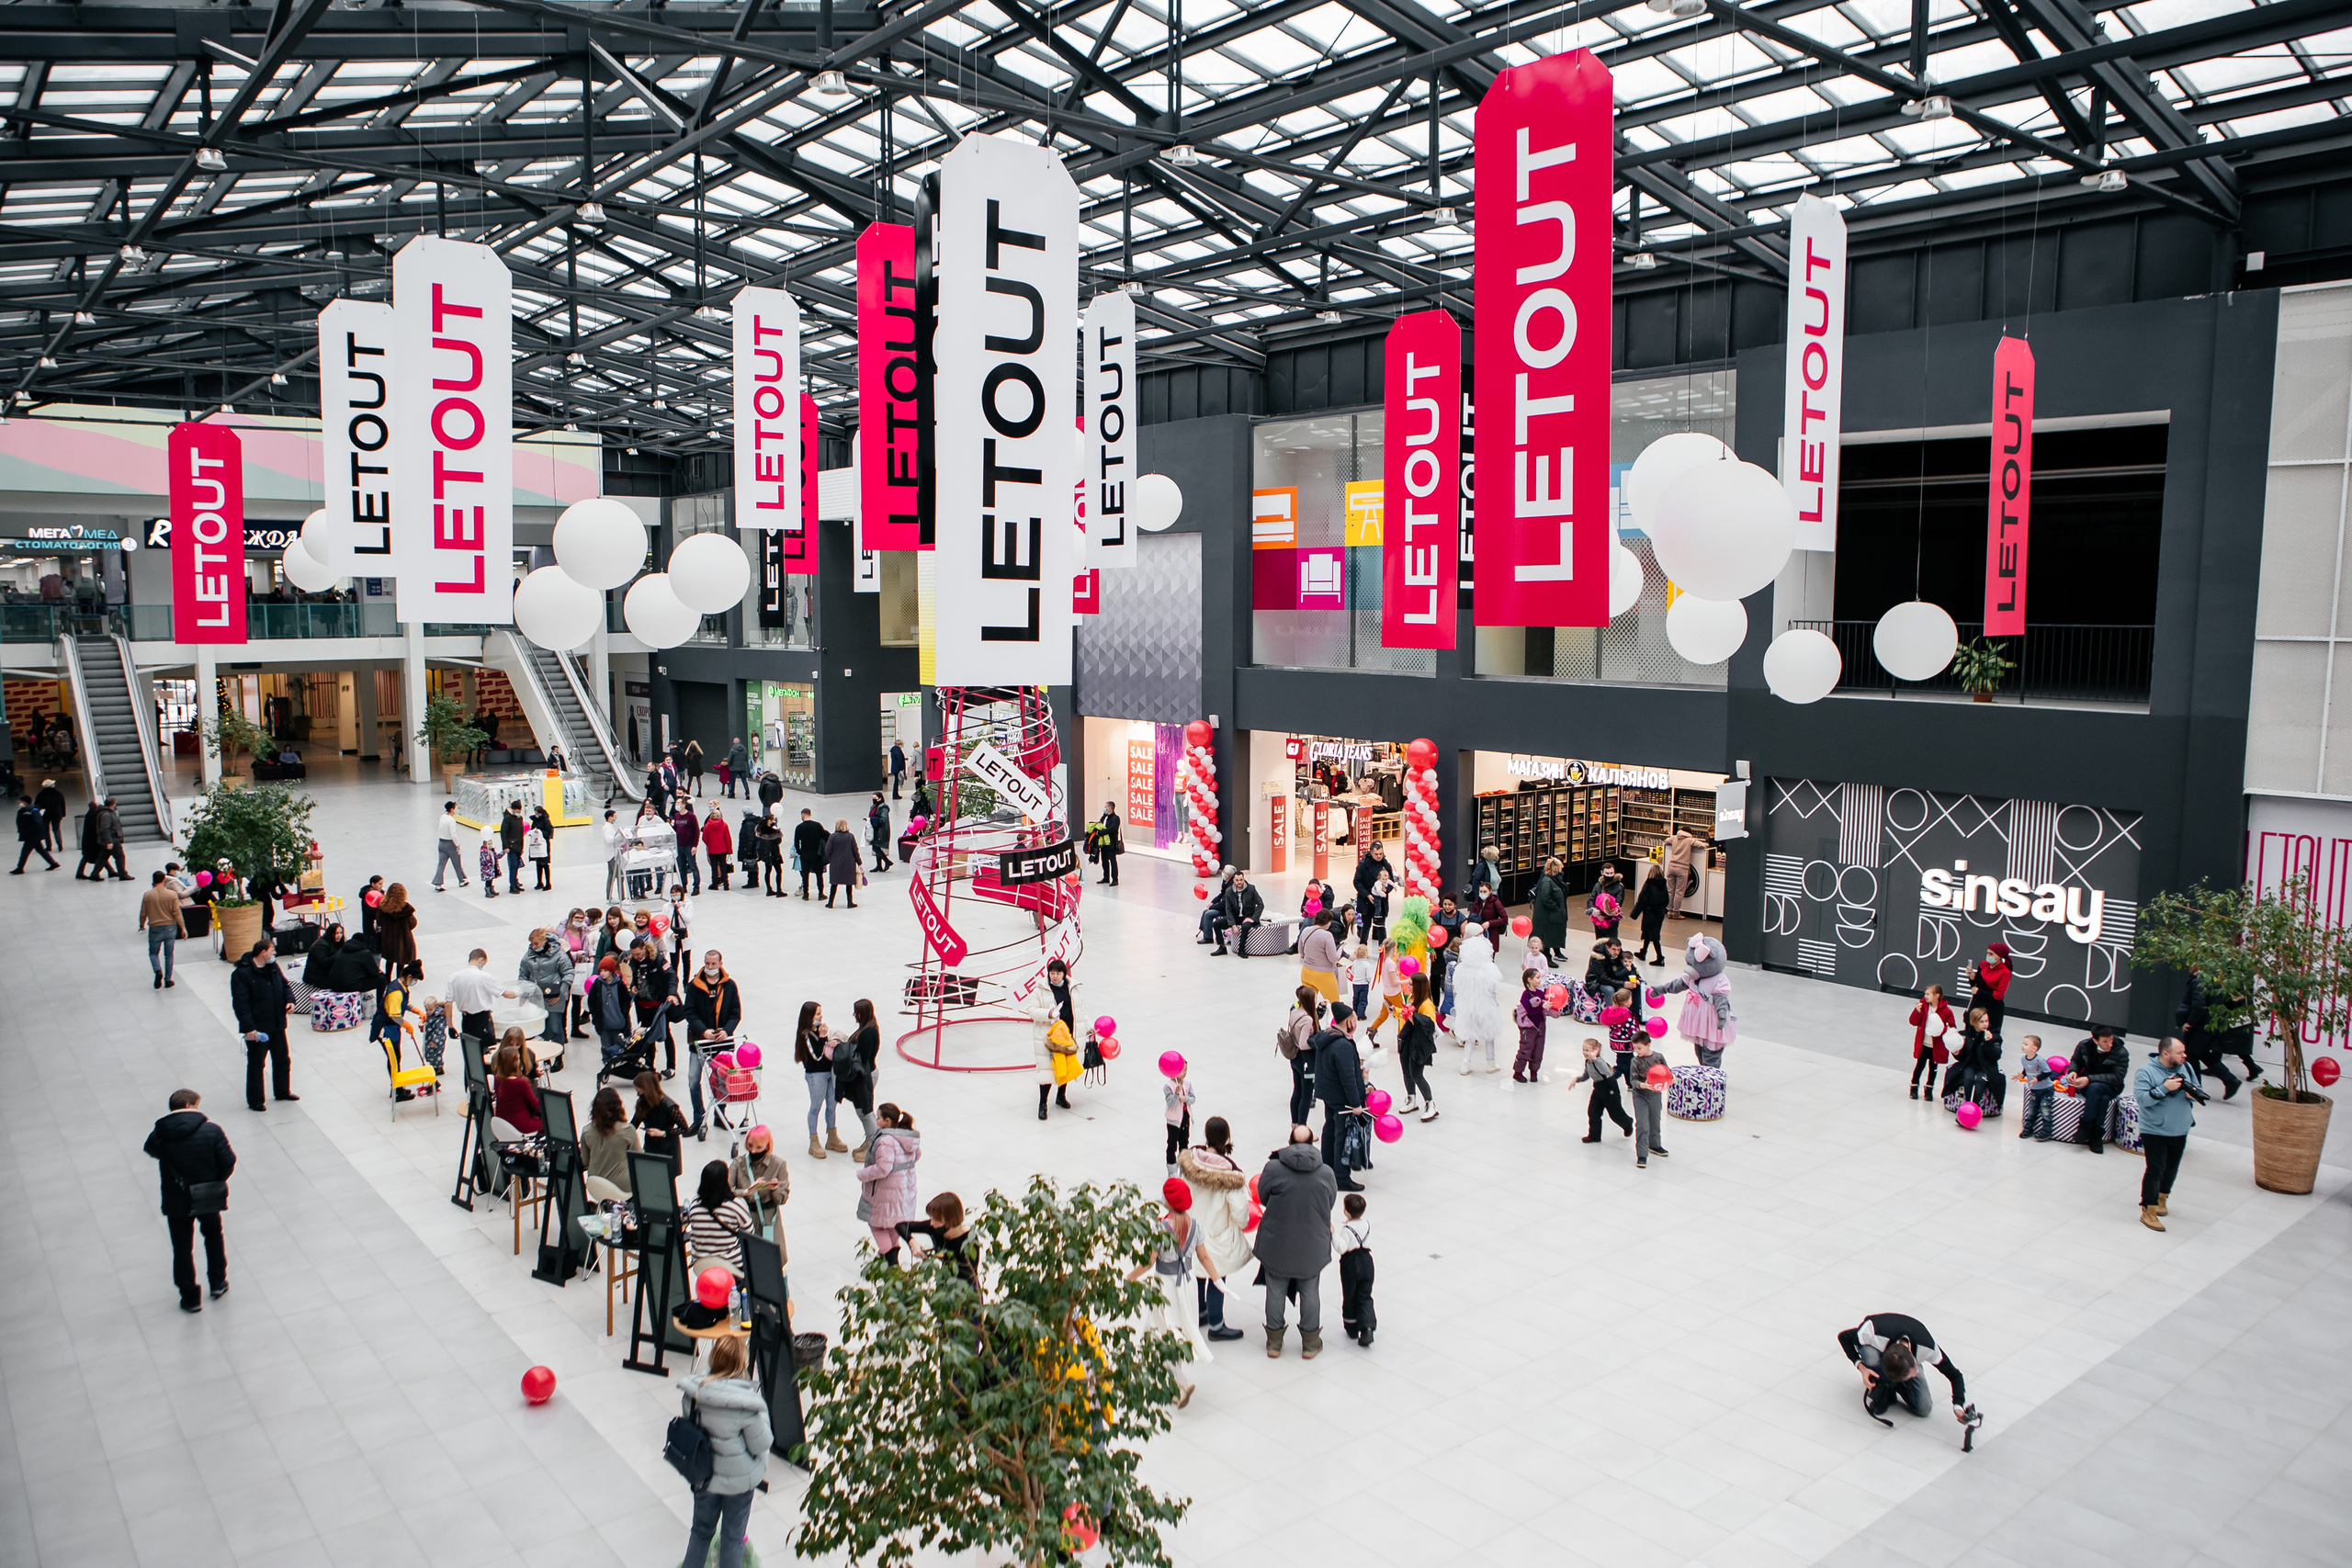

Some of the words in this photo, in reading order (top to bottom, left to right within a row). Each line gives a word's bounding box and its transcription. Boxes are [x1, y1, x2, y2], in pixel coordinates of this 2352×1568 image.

[1514, 126, 1578, 583] LETOUT
[1799, 236, 1832, 523] LETOUT
[752, 314, 786, 510] LETOUT
[884, 260, 920, 525] LETOUT
[980, 198, 1046, 642] LETOUT
[346, 332, 391, 555] LETOUT
[430, 282, 486, 594] LETOUT
[1100, 326, 1125, 547] LETOUT
[1403, 352, 1441, 626] LETOUT
[1996, 370, 2023, 614] LETOUT
[16, 540, 120, 550] СТОМАТОЛОГИЯ
[28, 527, 72, 539] МЕГА
[84, 529, 119, 539] МЕД
[191, 446, 230, 626] LETOUT
[975, 752, 1043, 811] LETOUT
[1130, 746, 1153, 761] SALE
[1130, 761, 1153, 775] SALE
[1310, 741, 1342, 761] GLORIA
[1341, 744, 1373, 764] JEANS
[1508, 760, 1566, 780] МАГАЗИН
[1588, 766, 1669, 791] КАЛЬЯНОВ
[1130, 776, 1153, 791] SALE
[1130, 792, 1153, 807] SALE
[1130, 807, 1153, 821] SALE
[1274, 805, 1284, 846] SALE
[1316, 810, 1327, 853] SALE
[1719, 808, 1744, 823] sinsay
[1008, 849, 1072, 879] LETOUT
[911, 882, 958, 954] LETOUT
[1921, 859, 2105, 944] sinsay
